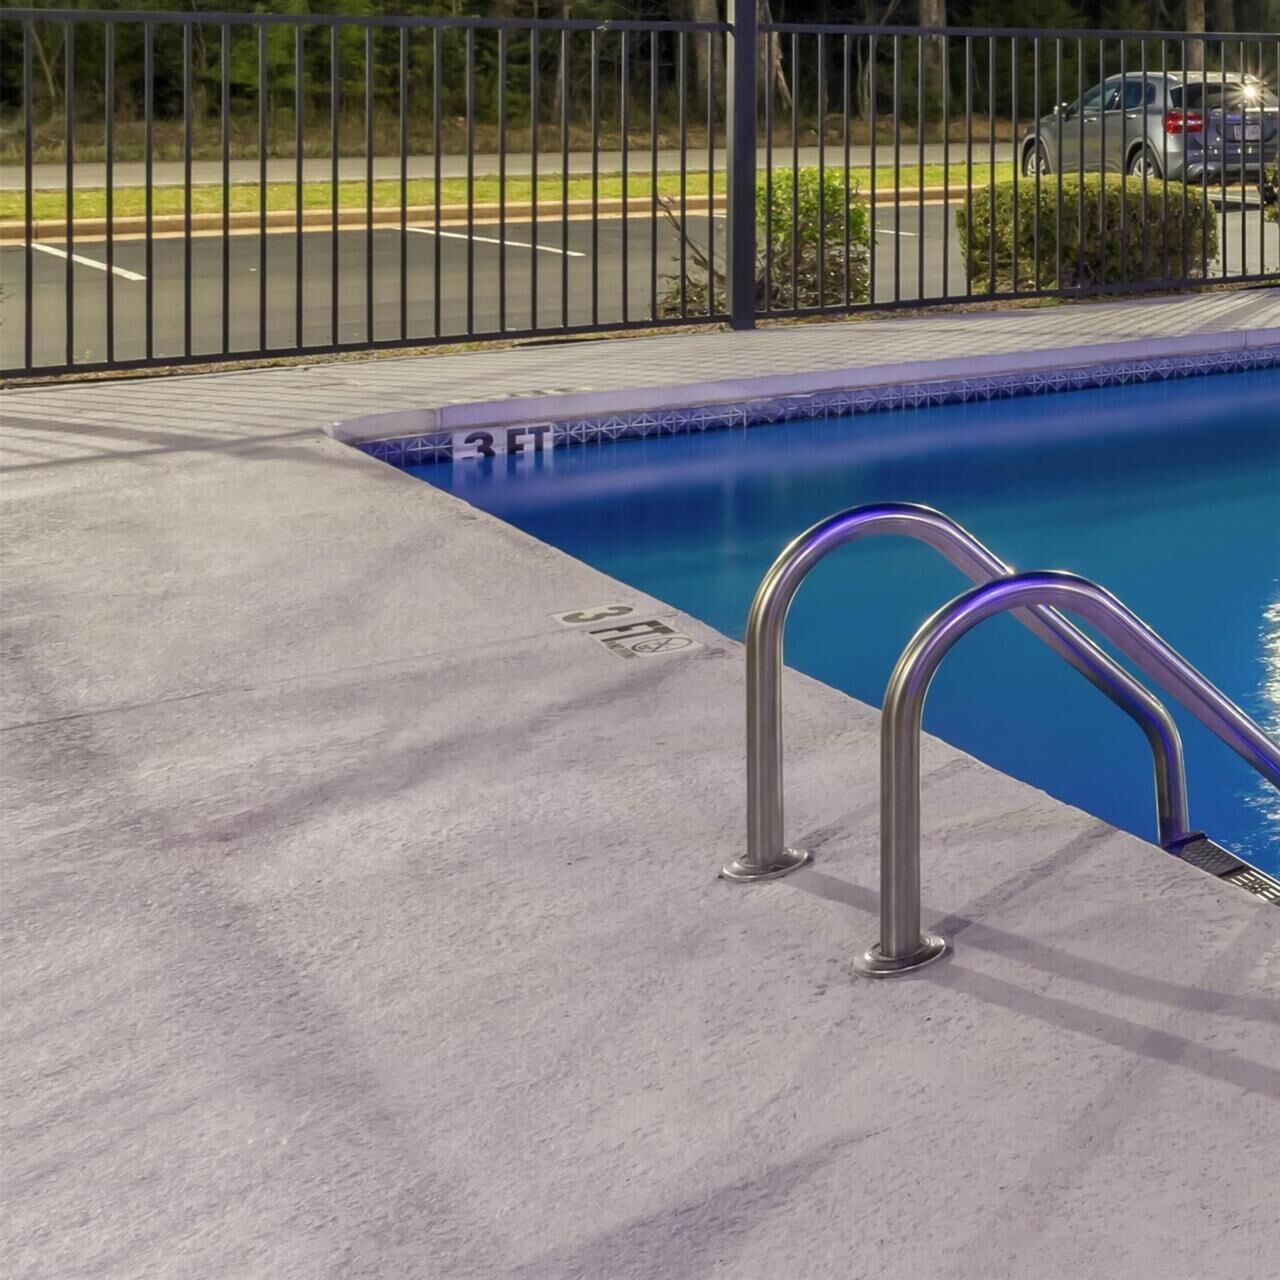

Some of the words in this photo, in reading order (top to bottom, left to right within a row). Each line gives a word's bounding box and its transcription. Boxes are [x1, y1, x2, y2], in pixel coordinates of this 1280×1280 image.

[461, 431, 496, 460] 3
[506, 424, 551, 456] FT
[562, 605, 634, 624] 3
